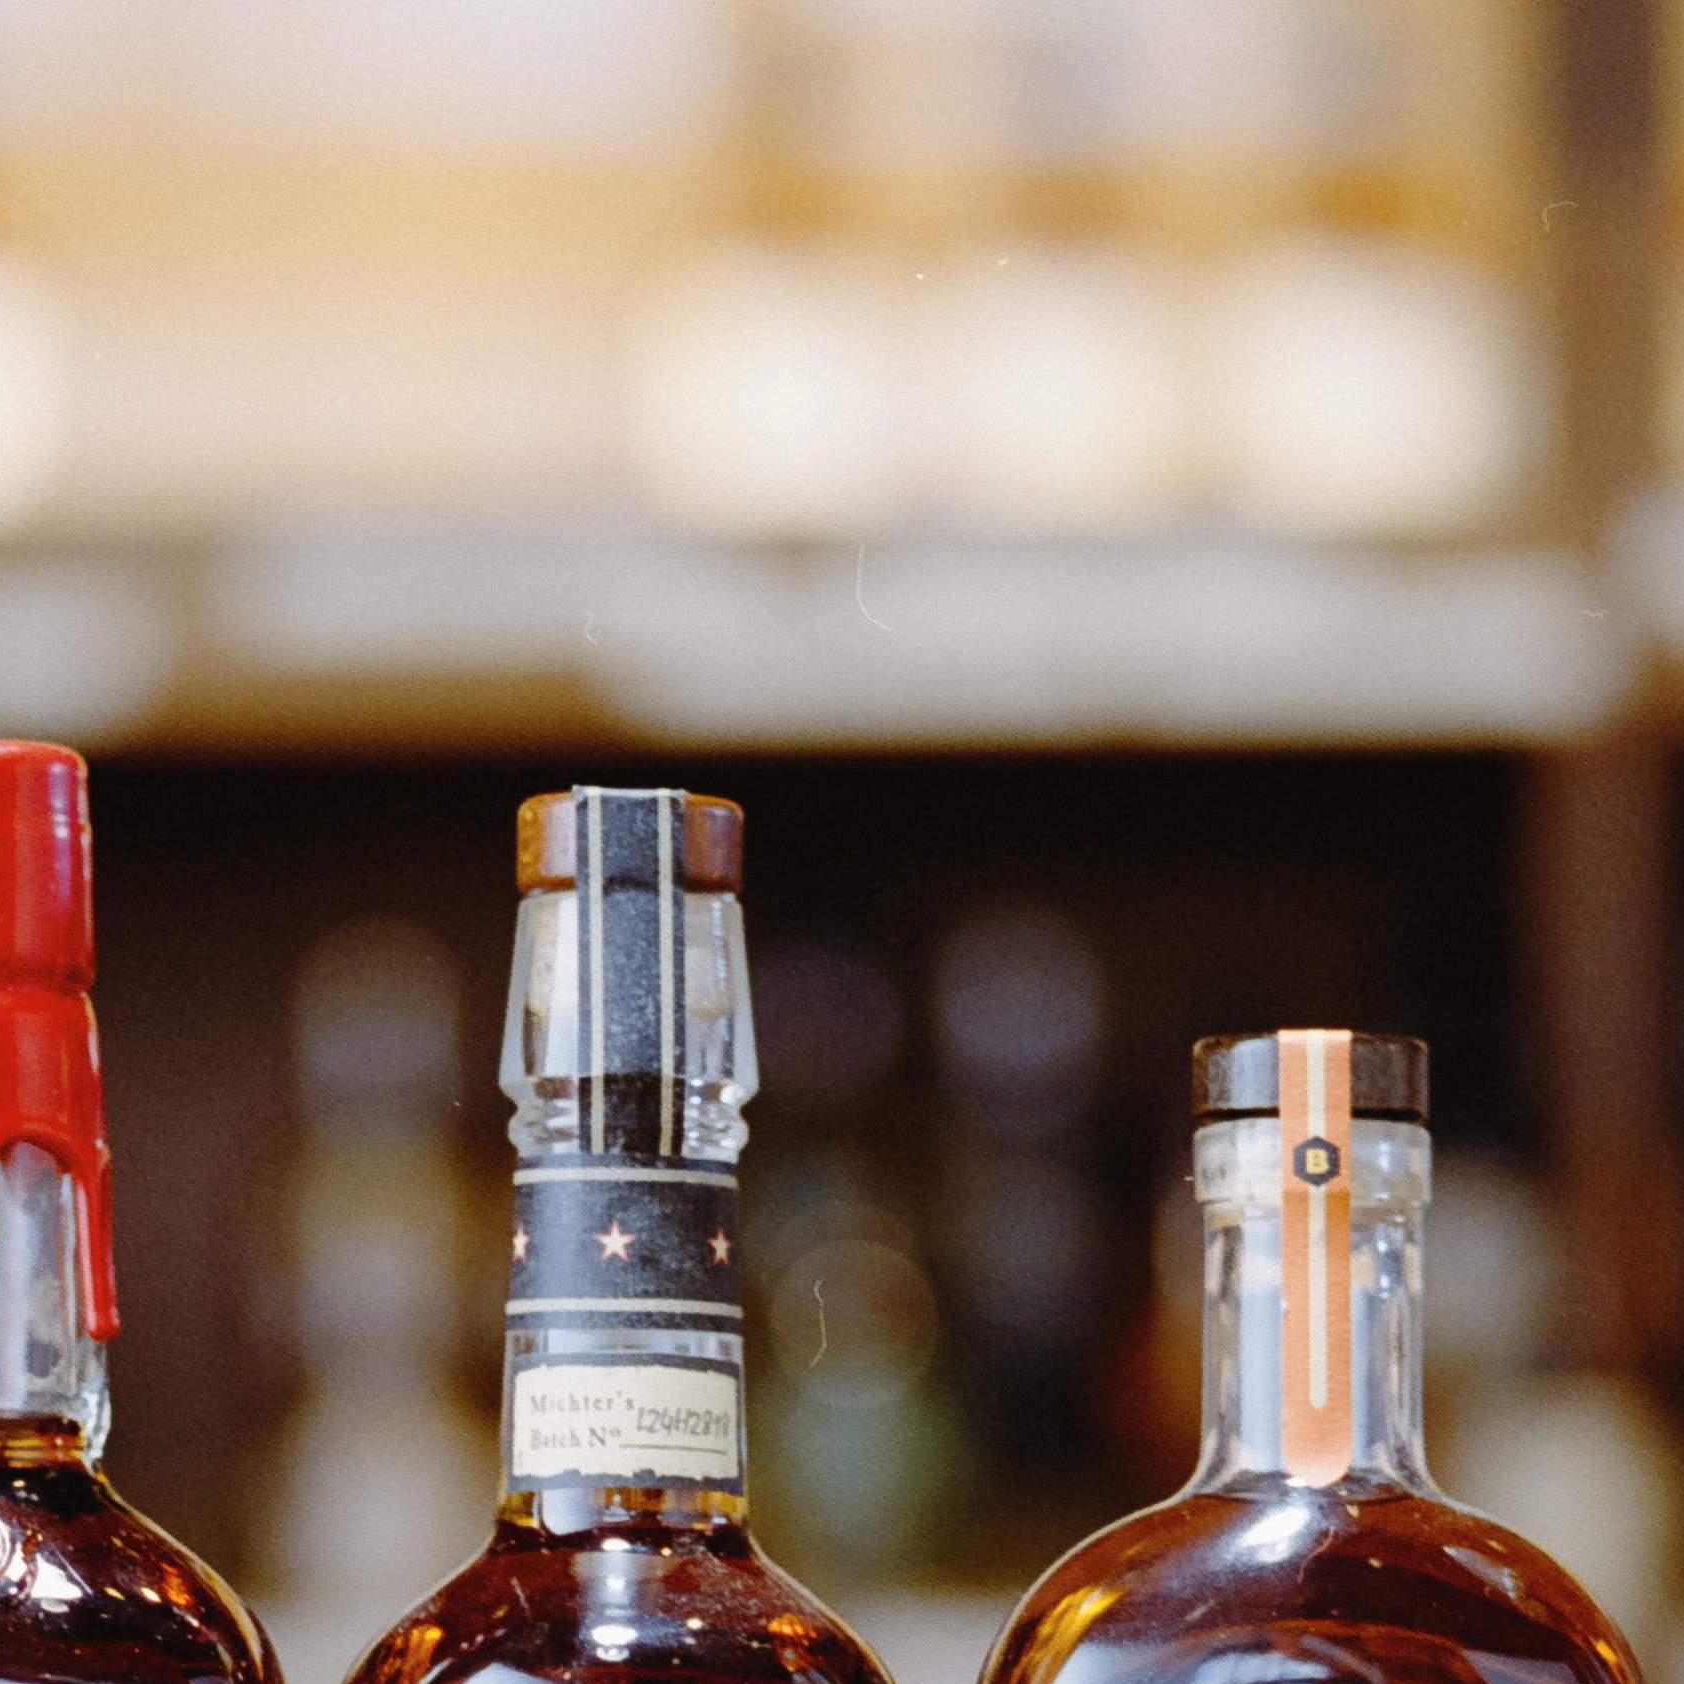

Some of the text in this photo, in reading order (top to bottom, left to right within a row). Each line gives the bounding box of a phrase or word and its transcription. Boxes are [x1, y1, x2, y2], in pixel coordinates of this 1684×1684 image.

[1305, 1148, 1330, 1175] B
[530, 1390, 635, 1415] Michter's
[530, 1428, 581, 1449] Batch
